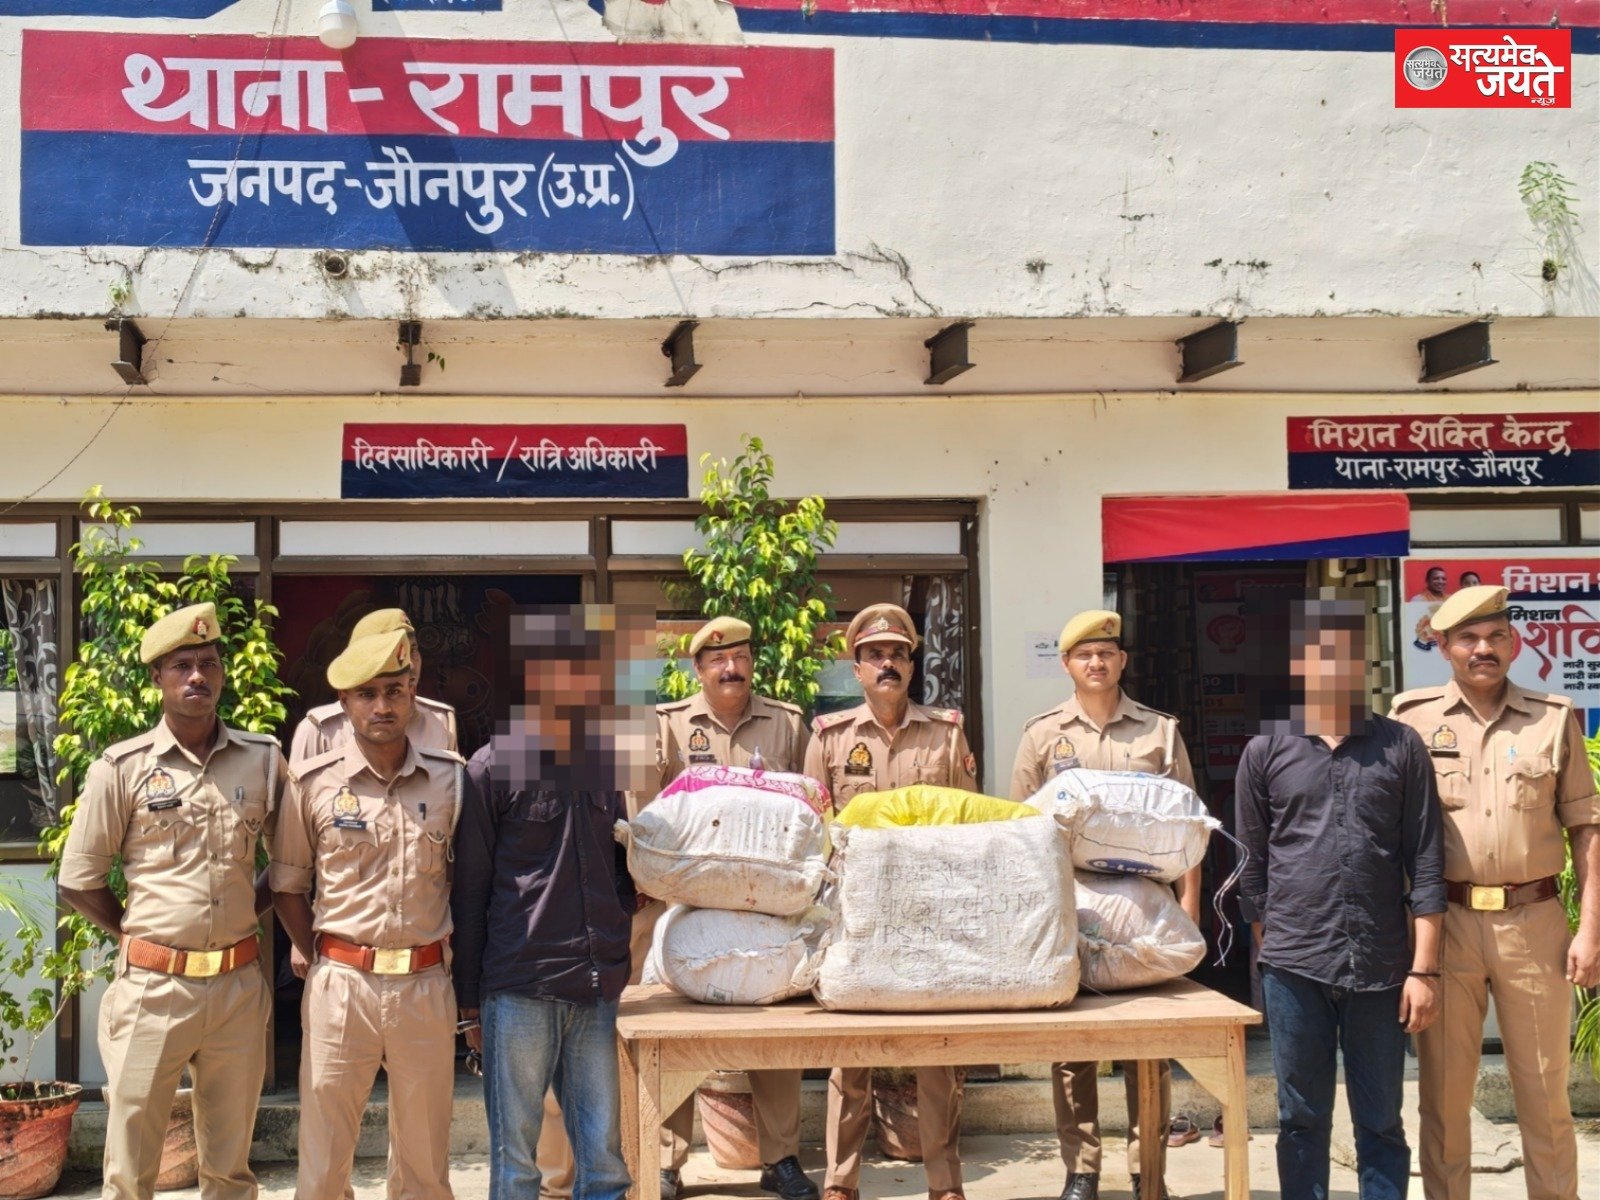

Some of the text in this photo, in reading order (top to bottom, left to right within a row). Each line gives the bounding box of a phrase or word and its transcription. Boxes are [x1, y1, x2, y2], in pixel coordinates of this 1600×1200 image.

[122, 53, 344, 131] थाना
[404, 61, 742, 167] रामपुर
[1307, 418, 1401, 452] मिशन
[1408, 416, 1494, 452] शक्ति
[351, 437, 495, 473] दिवसाधिकारी
[519, 438, 565, 472] रात्रि
[566, 436, 665, 473] अधिकारी
[1502, 566, 1590, 593] मिशन
